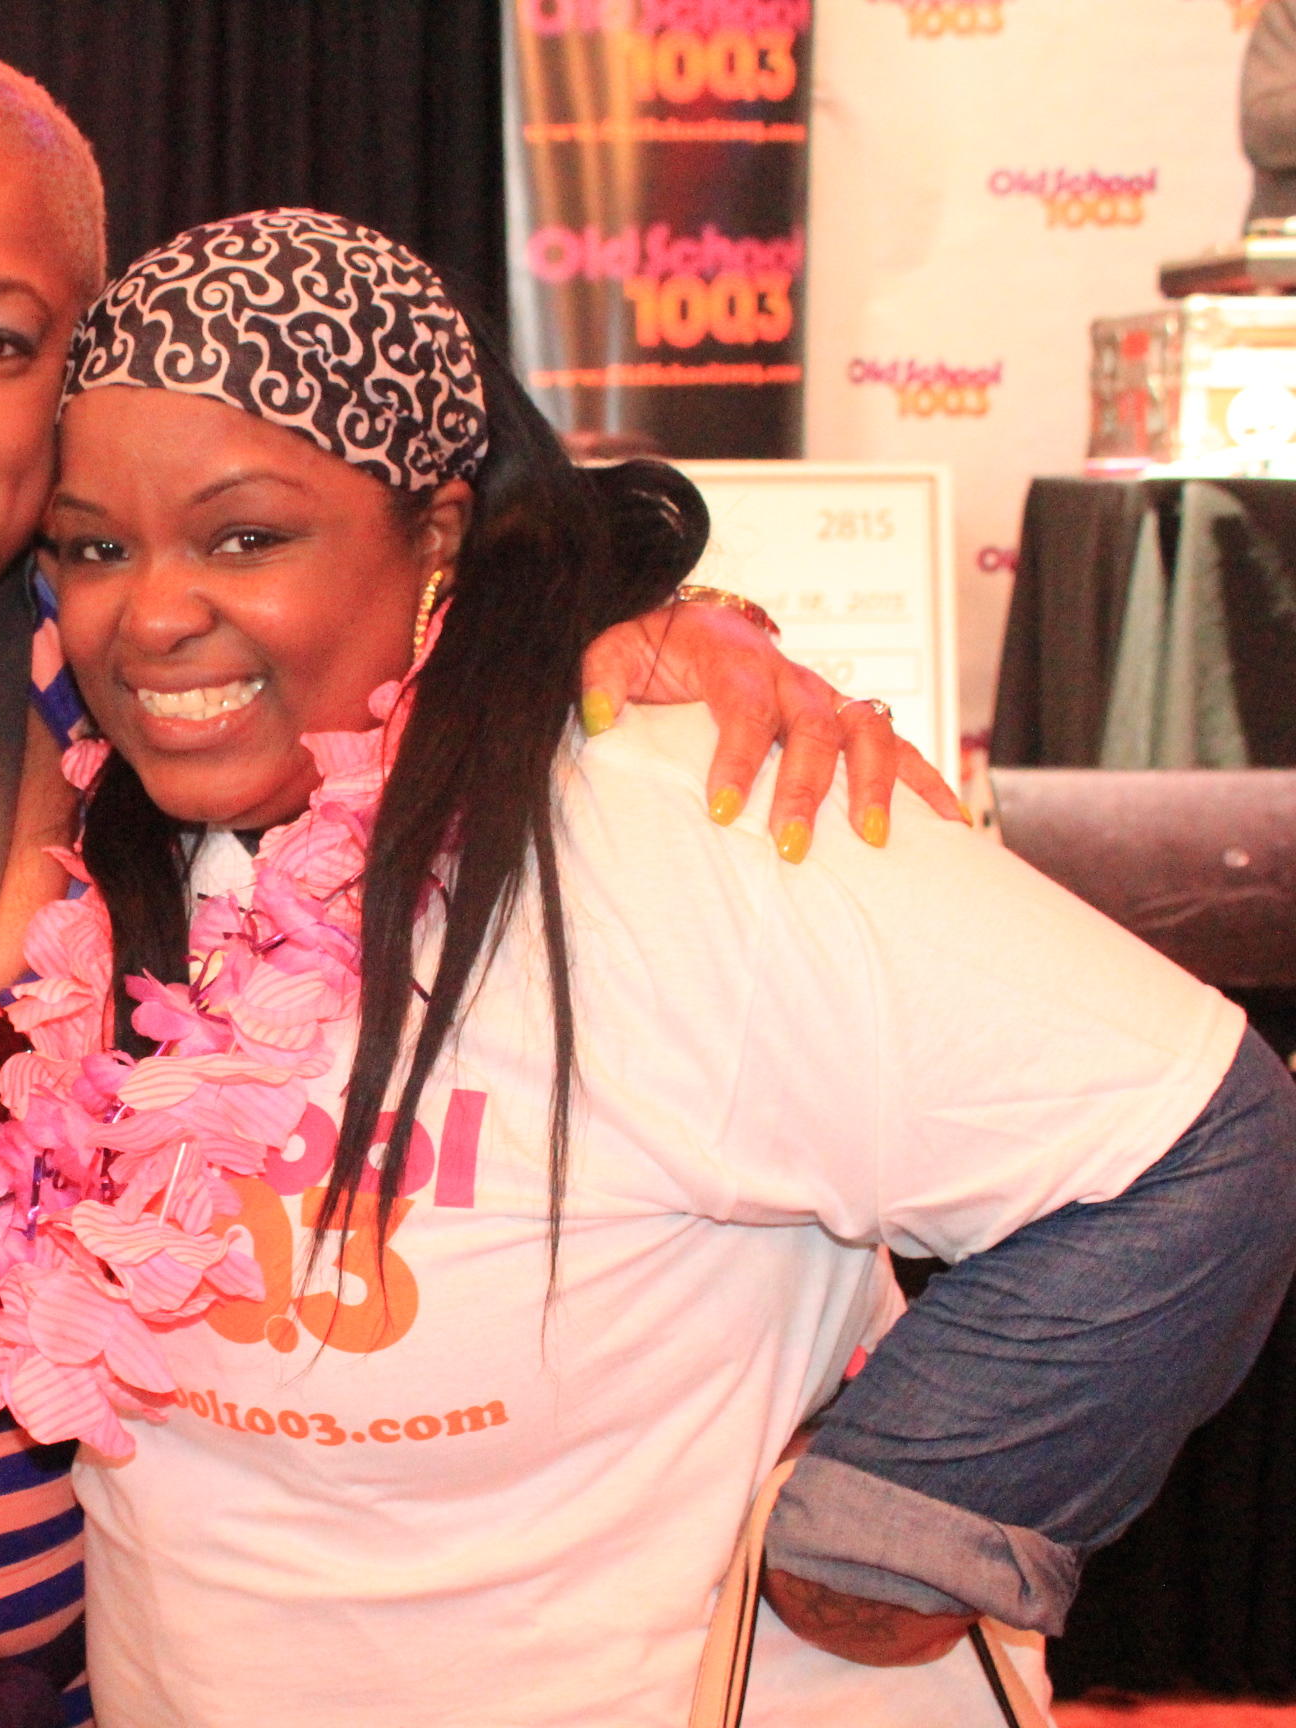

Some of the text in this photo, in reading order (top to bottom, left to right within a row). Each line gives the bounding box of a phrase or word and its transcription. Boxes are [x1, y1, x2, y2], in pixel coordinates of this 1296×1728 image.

[987, 168, 1158, 198] Old School
[526, 222, 806, 284] Old School
[848, 358, 1003, 386] Old School
[816, 507, 896, 542] 2815
